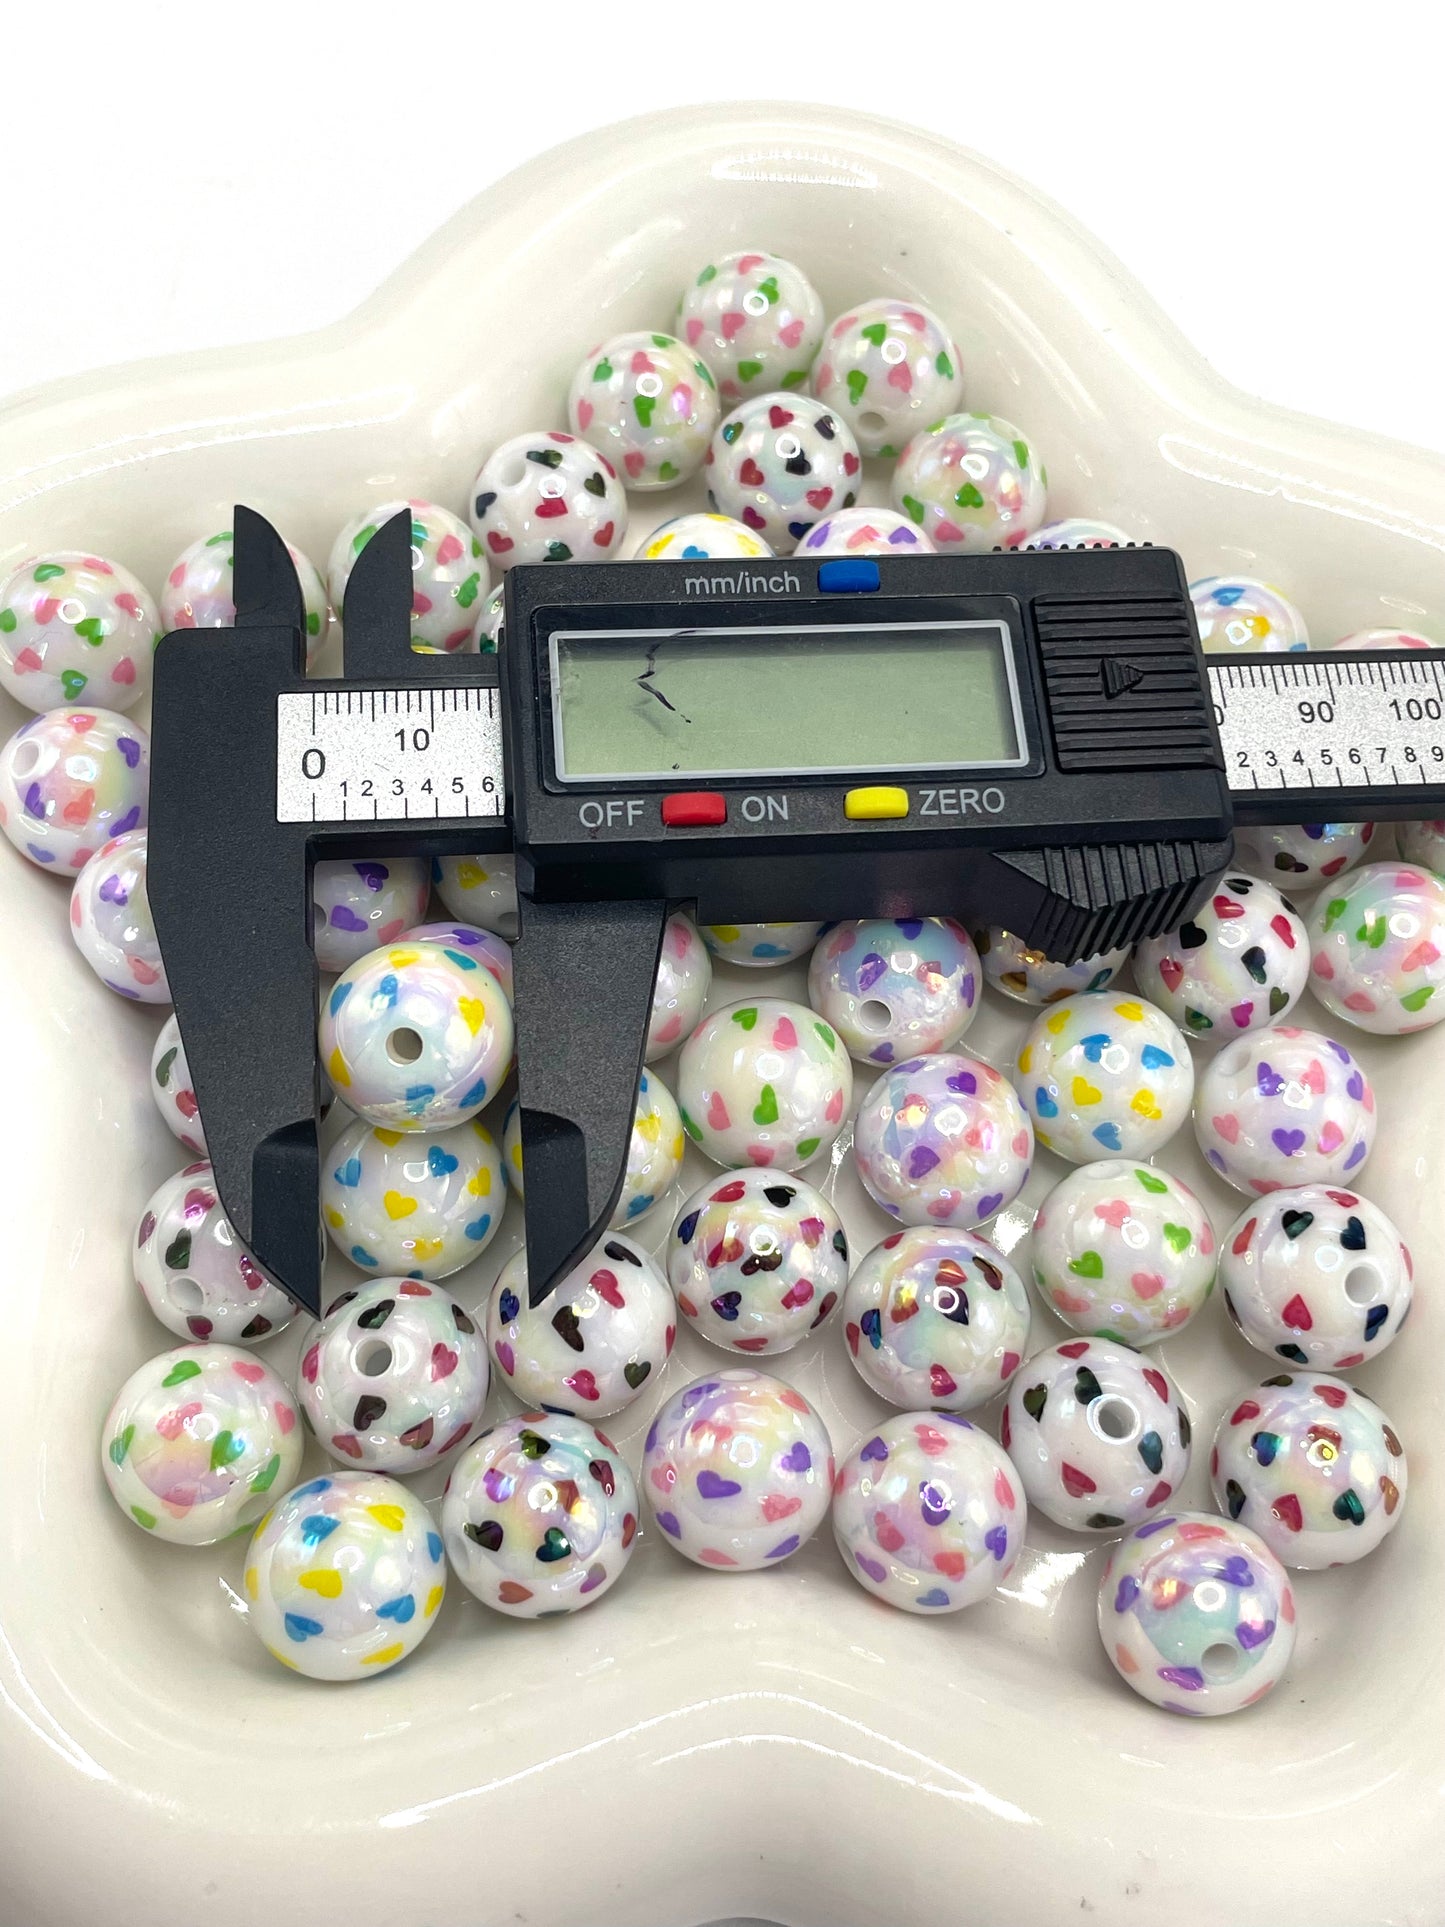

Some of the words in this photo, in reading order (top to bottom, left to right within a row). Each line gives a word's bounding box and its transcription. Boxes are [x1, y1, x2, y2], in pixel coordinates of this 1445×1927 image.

[684, 570, 801, 596] mm/inch
[1297, 700, 1335, 724] 90
[1388, 698, 1442, 721] 100
[394, 728, 430, 752] 10
[301, 748, 326, 780] 0
[1236, 751, 1251, 768] 2
[1265, 750, 1278, 767] 3
[1292, 749, 1305, 766] 4
[1320, 748, 1333, 765] 5
[1348, 748, 1361, 765] 6
[1375, 747, 1387, 764] 7
[1404, 746, 1417, 763] 8
[1431, 745, 1444, 762] 9
[339, 780, 348, 797] 1
[361, 779, 374, 797] 2
[391, 778, 405, 796] 3
[420, 778, 434, 795] 4
[451, 776, 464, 794] 5
[482, 775, 495, 793] 6
[578, 800, 645, 829] OFF
[740, 795, 790, 823] ON
[919, 787, 1005, 817] ZERO
